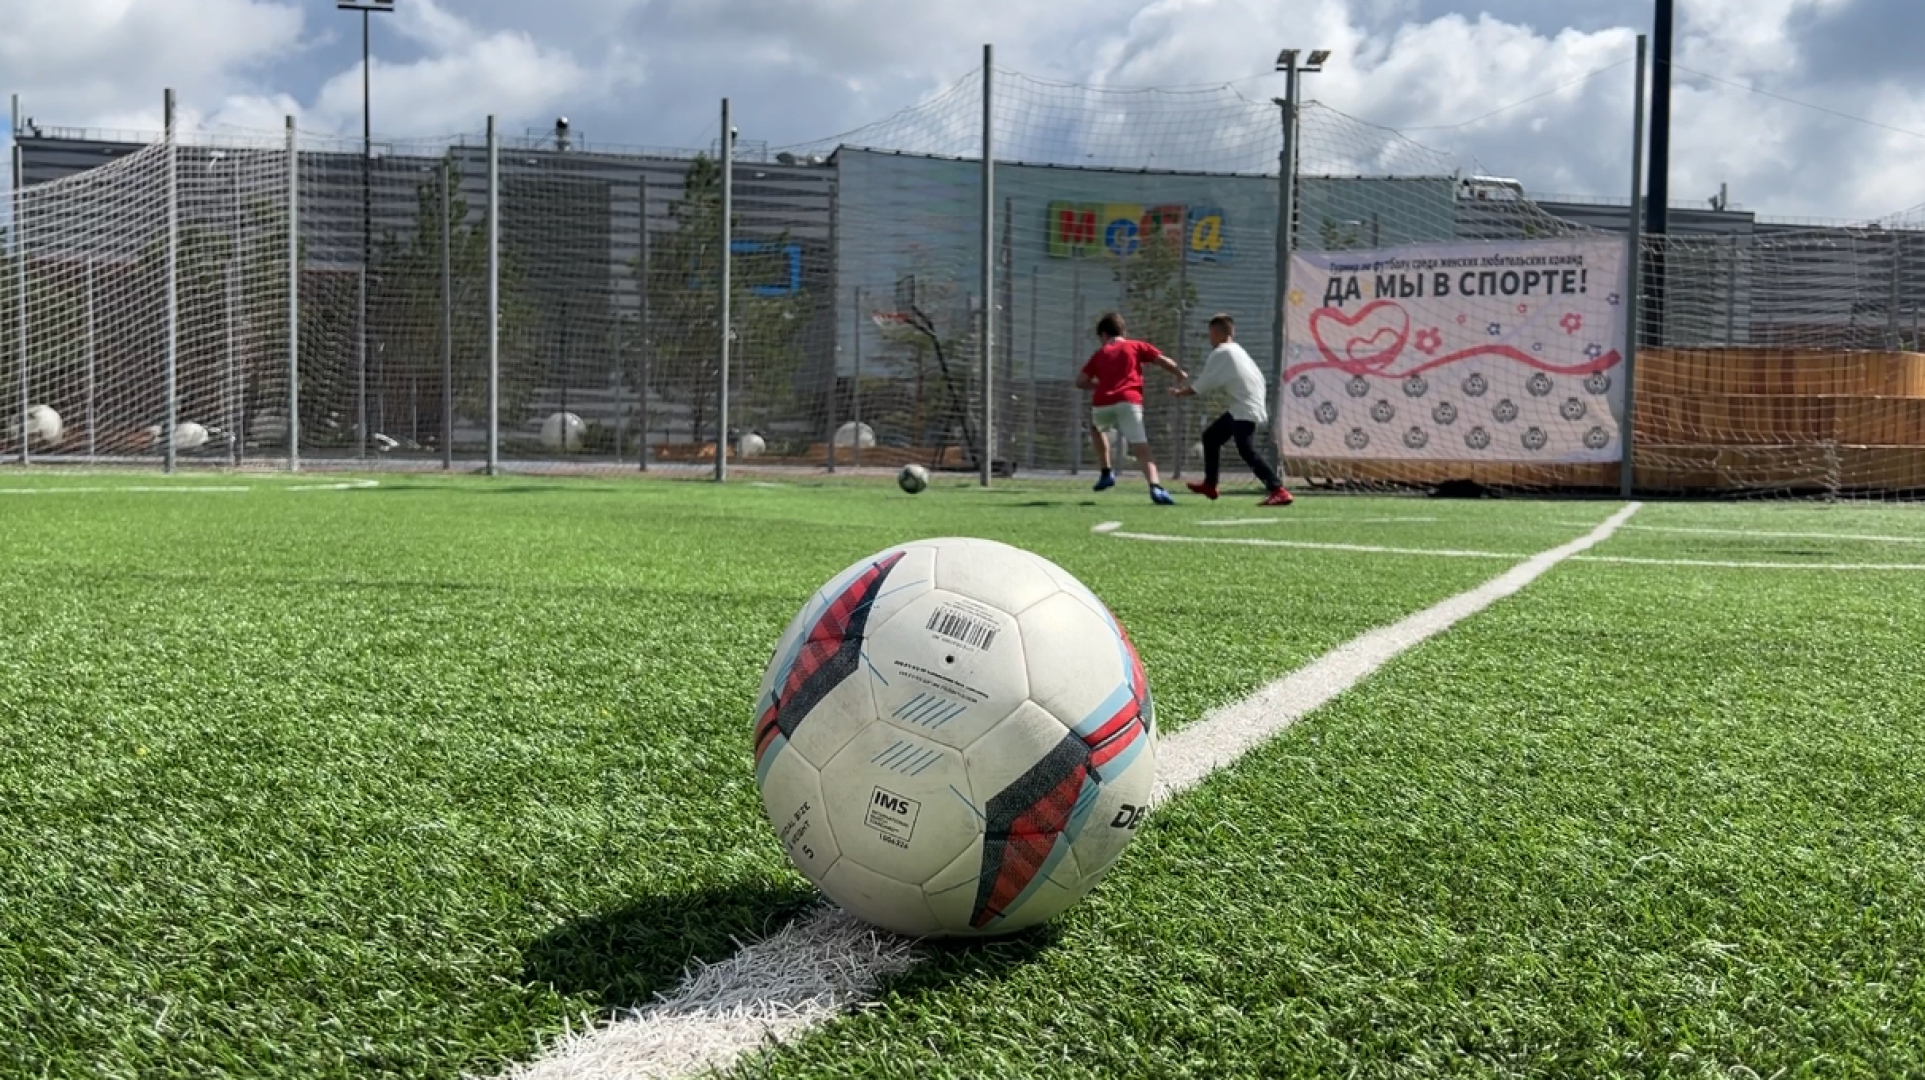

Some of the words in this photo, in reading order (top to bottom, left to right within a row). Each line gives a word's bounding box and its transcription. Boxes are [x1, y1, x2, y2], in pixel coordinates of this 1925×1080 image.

[1374, 257, 1410, 273] футболу
[1440, 257, 1478, 268] женских
[1480, 253, 1546, 267] любительских
[1549, 255, 1583, 268] команд
[1324, 275, 1361, 308] ДА
[1376, 272, 1424, 298] МЫ
[1433, 272, 1451, 296] В
[1459, 268, 1588, 296] СПОРТЕ!
[875, 790, 910, 816] IMS
